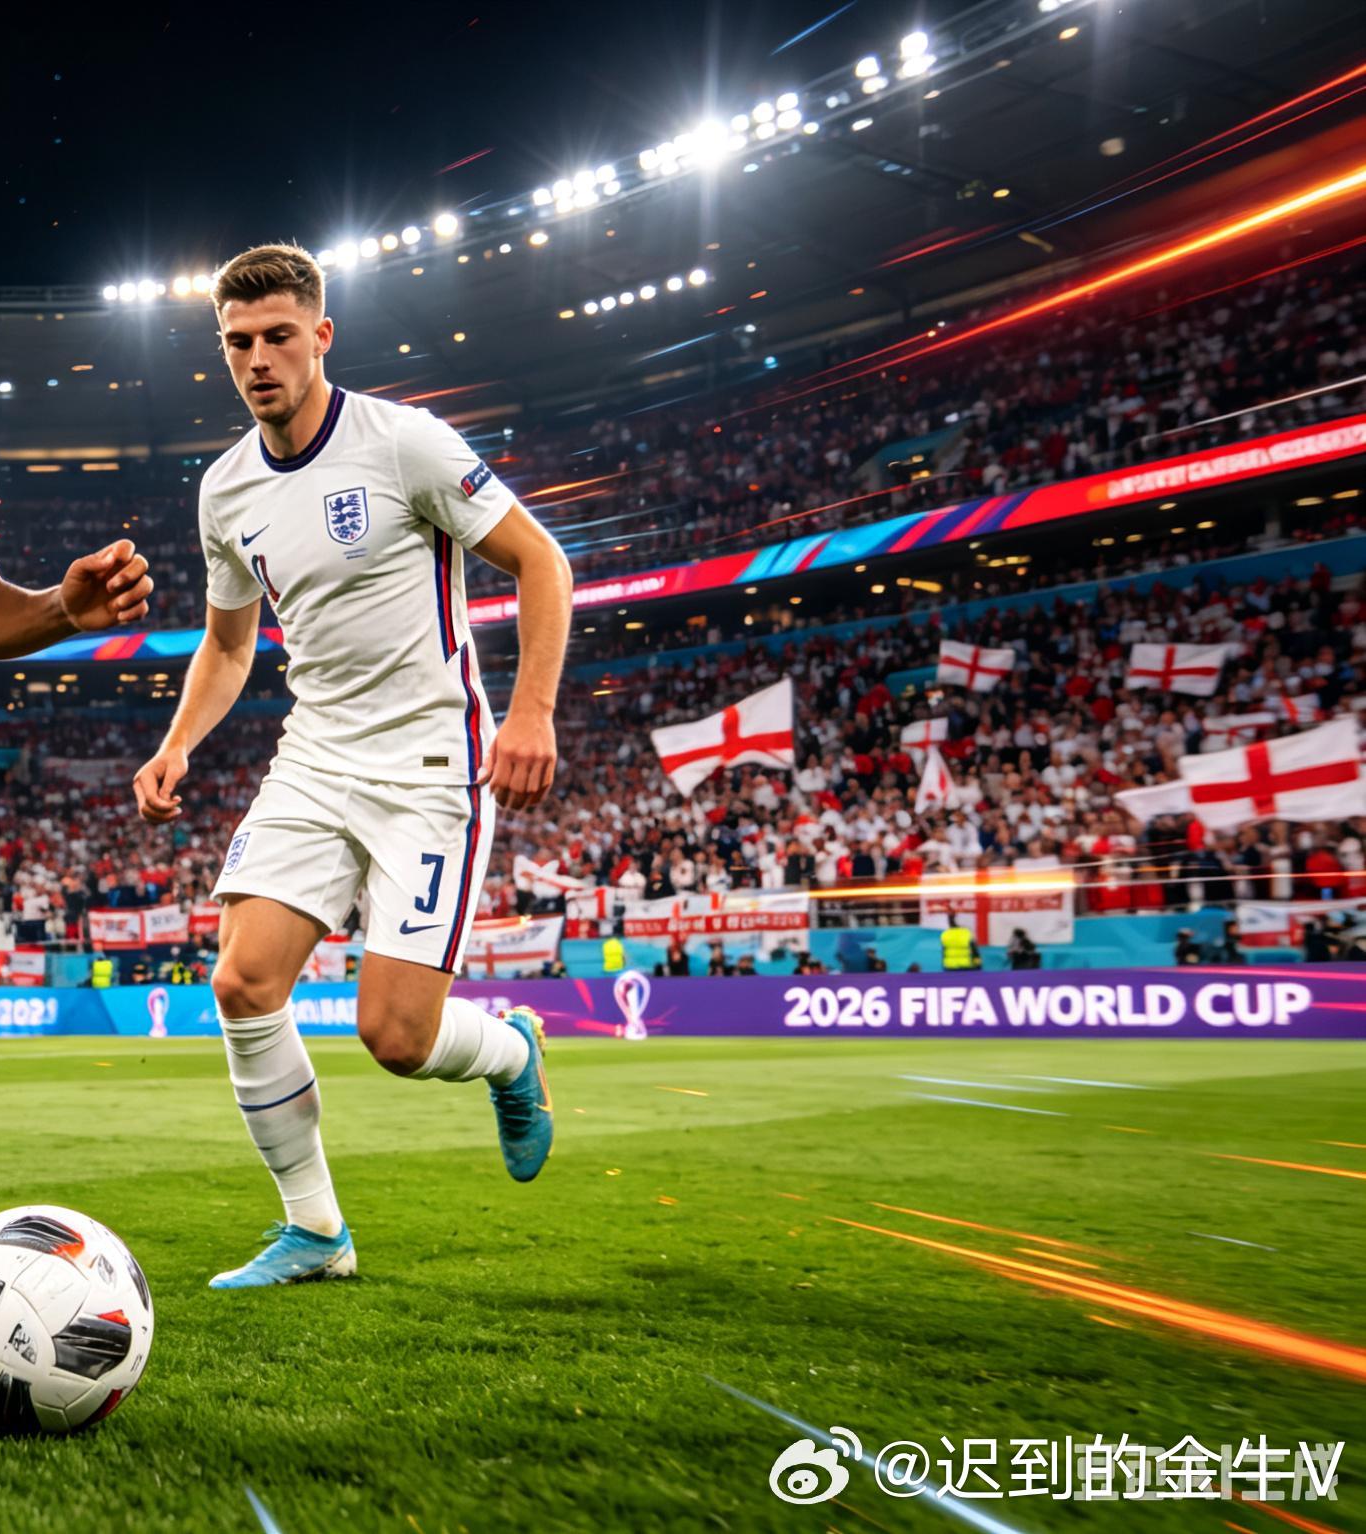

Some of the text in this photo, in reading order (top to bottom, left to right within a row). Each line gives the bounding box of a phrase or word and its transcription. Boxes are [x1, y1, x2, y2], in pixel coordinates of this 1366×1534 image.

[784, 982, 1312, 1027] 2026 FIFA WORLD CUP
